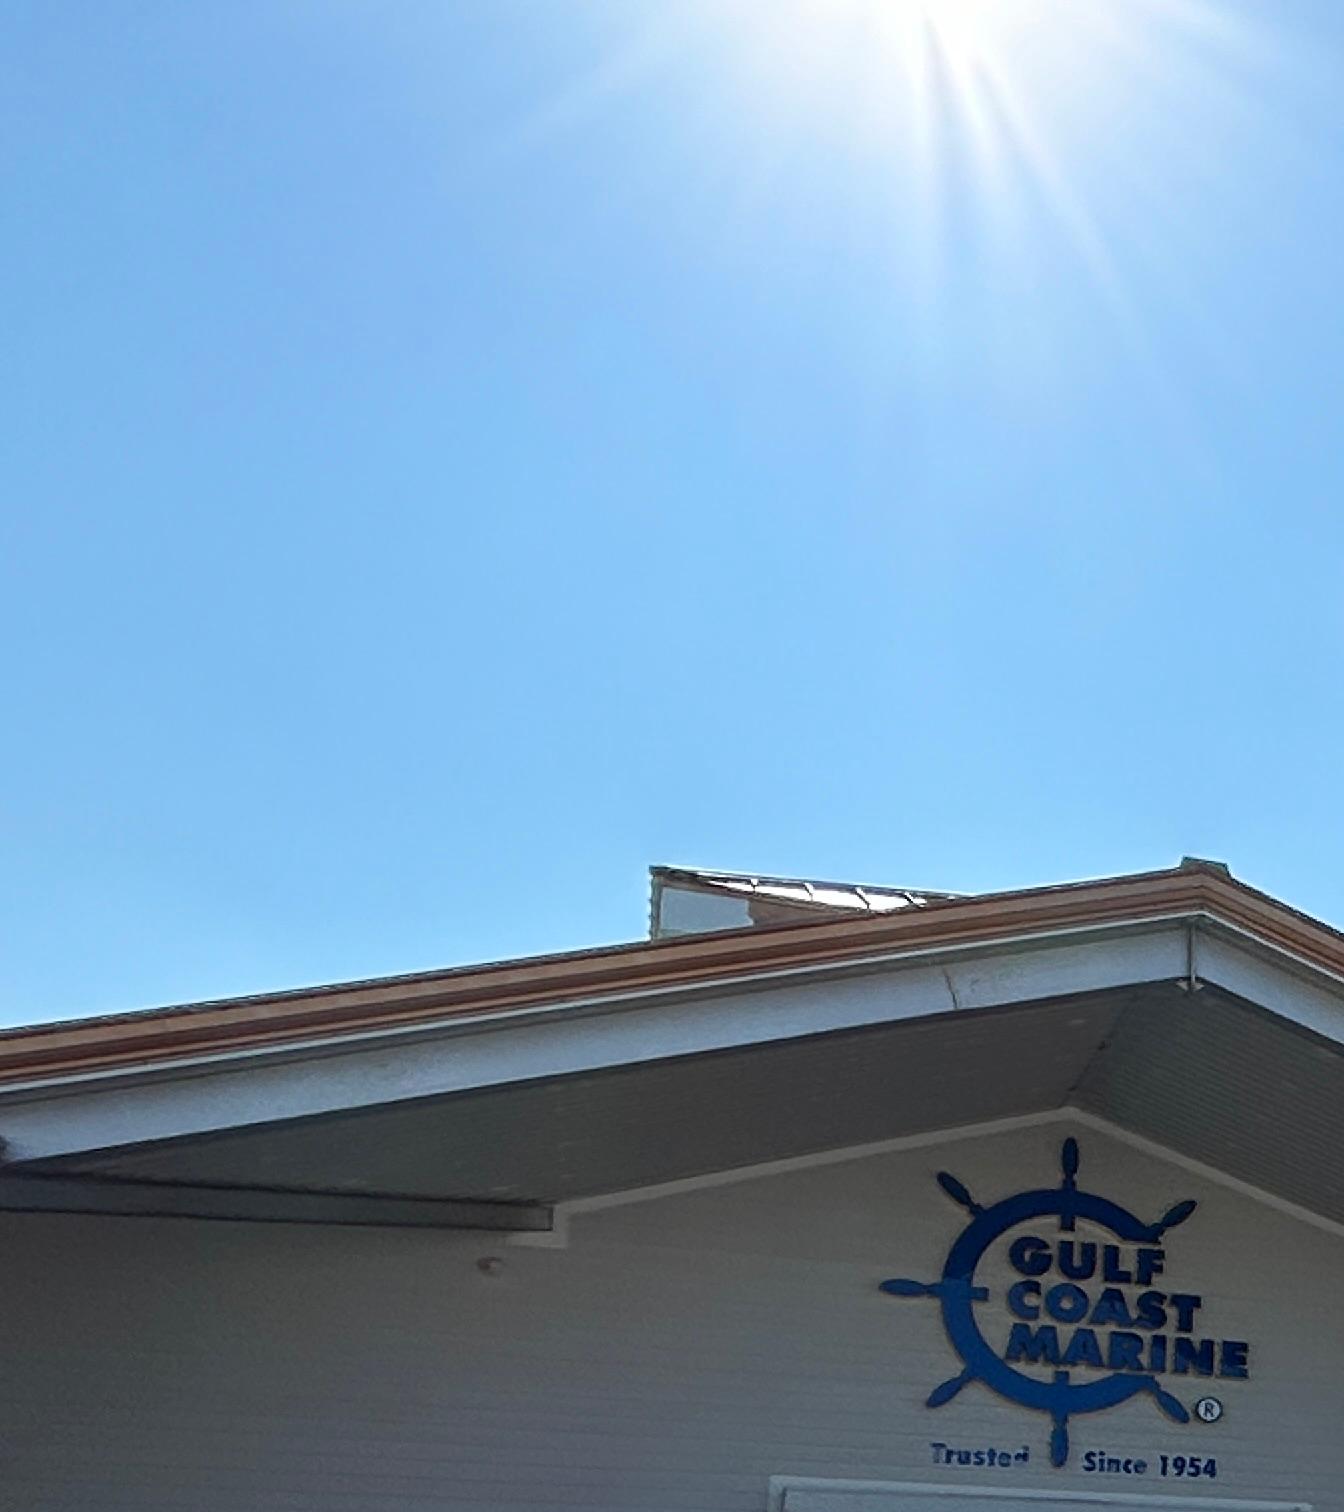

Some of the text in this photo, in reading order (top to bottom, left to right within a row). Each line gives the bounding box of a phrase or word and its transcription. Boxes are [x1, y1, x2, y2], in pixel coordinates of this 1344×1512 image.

[1009, 1237, 1165, 1285] GULF
[1007, 1281, 1201, 1333] COAST
[1006, 1323, 1249, 1378] MARINE
[1083, 1450, 1148, 1475] Since
[1159, 1454, 1217, 1479] 1954
